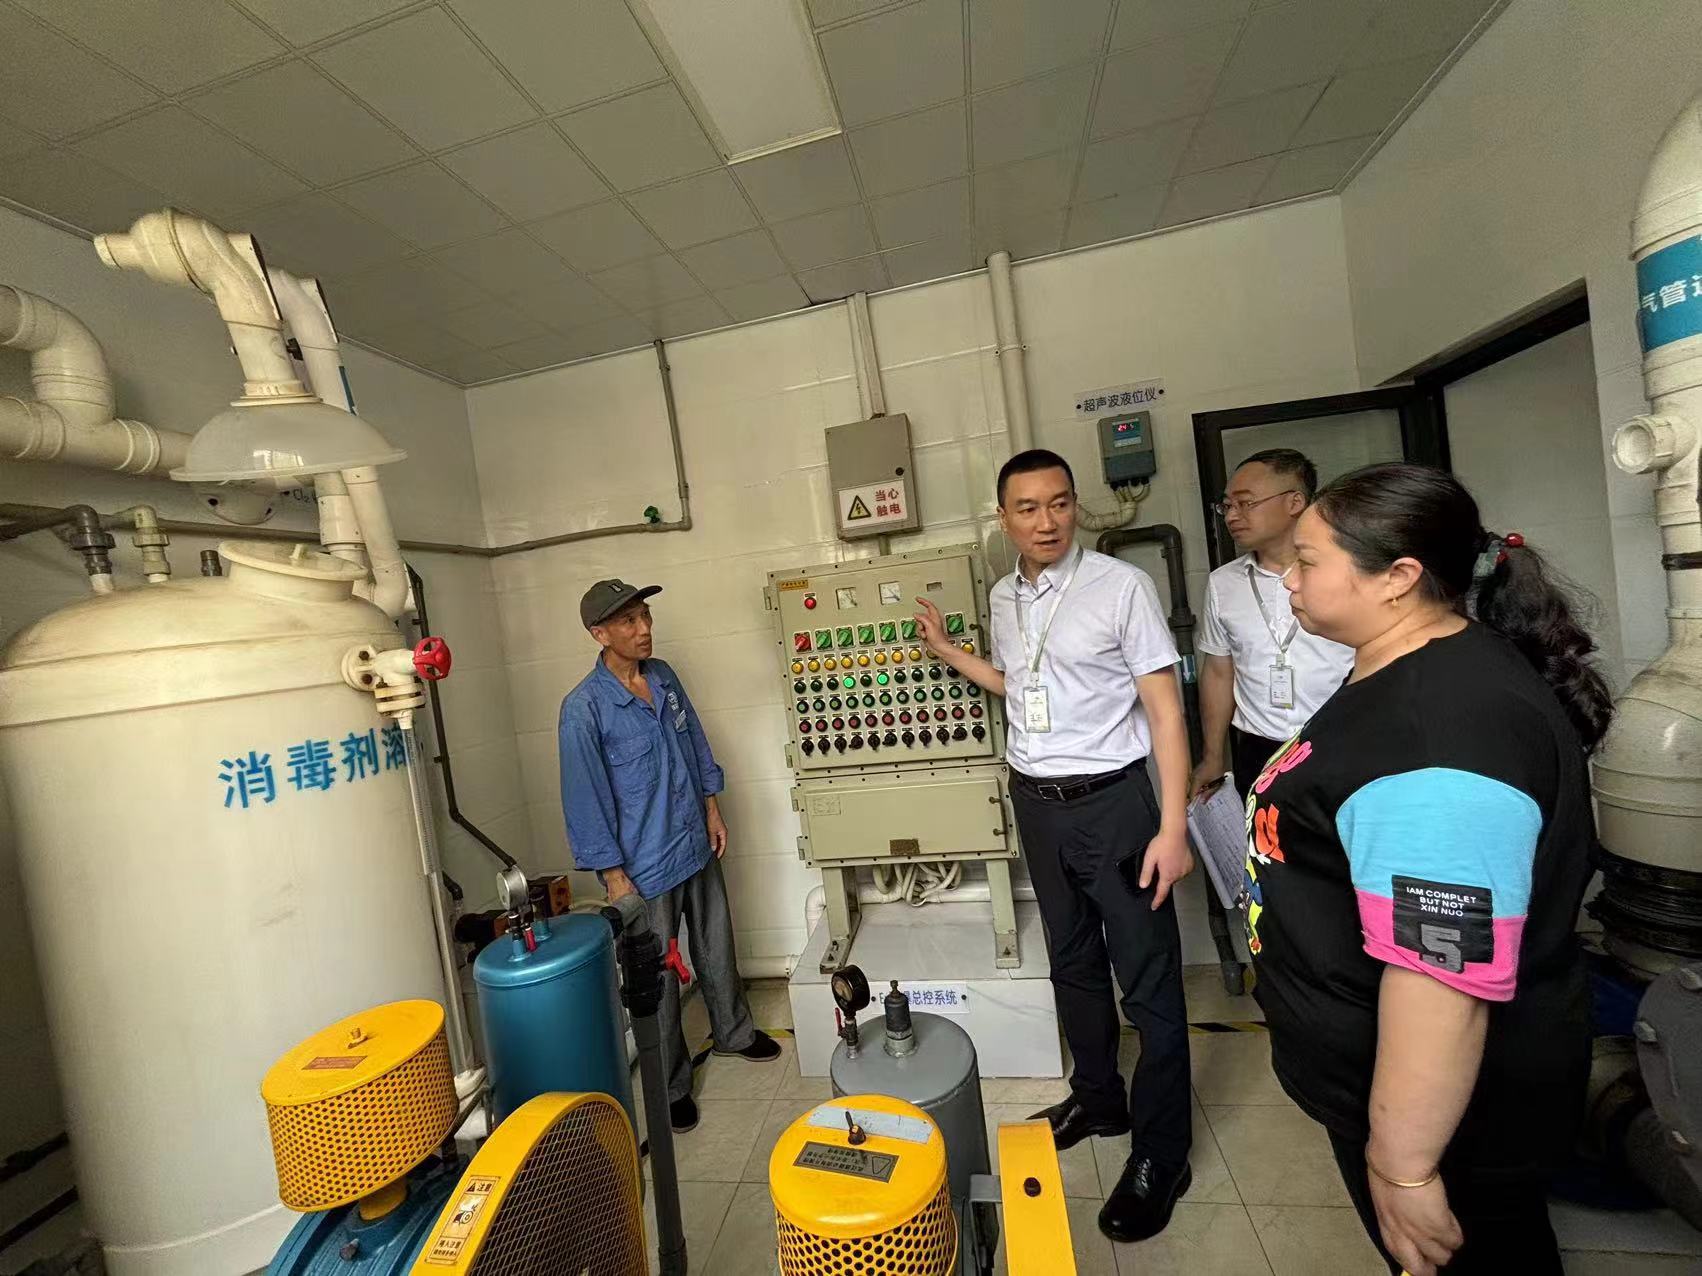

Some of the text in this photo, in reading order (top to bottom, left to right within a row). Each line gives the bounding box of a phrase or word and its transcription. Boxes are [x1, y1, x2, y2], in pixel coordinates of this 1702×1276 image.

[1083, 387, 1157, 412] 超声波液位仪
[875, 488, 899, 502] 当心
[876, 503, 901, 517] 触电
[1420, 896, 1465, 909] BUT NOT
[1426, 889, 1477, 904] COMPLET
[1421, 904, 1464, 917] XIN NUO
[1421, 923, 1463, 973] 5
